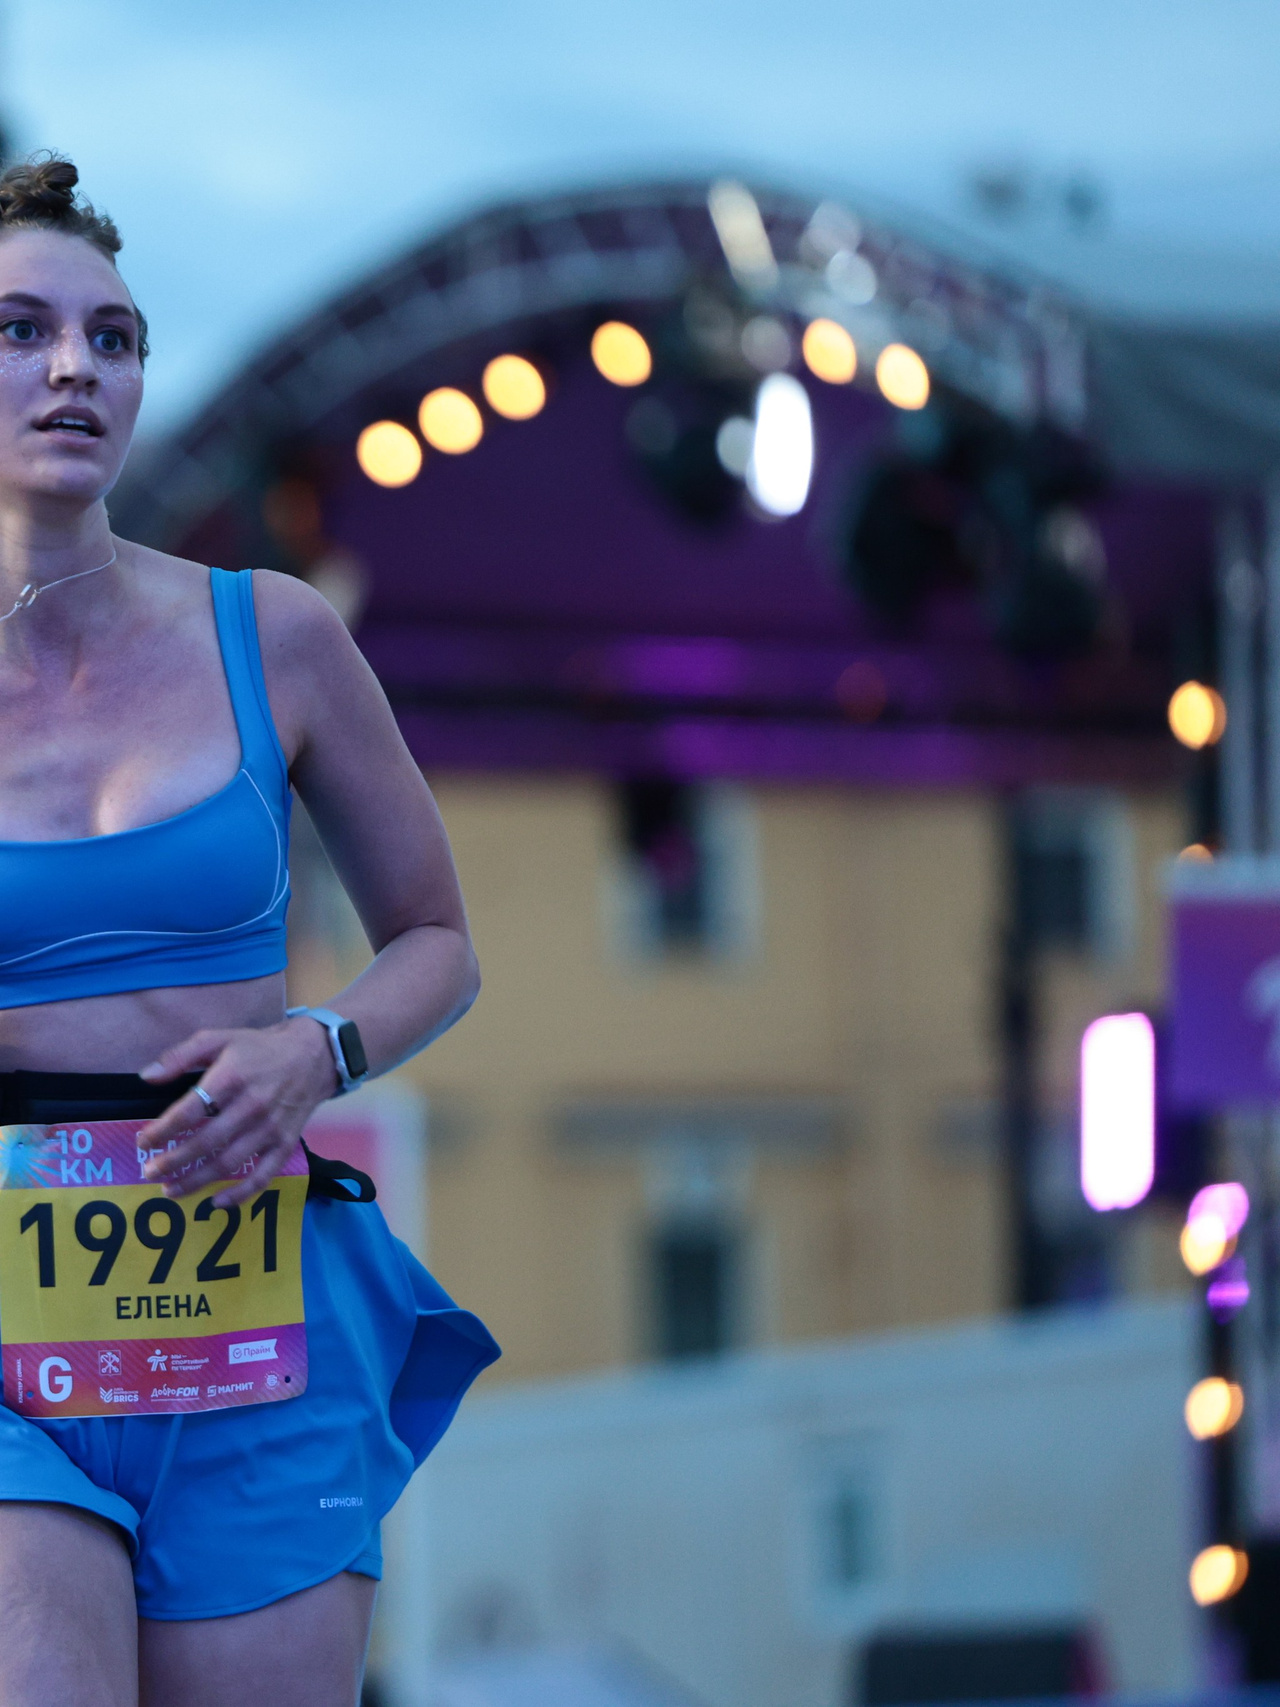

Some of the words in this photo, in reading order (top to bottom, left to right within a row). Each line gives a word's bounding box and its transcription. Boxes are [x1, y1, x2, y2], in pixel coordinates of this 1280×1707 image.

[55, 1128, 93, 1155] 10
[19, 1189, 281, 1288] 19921
[115, 1293, 212, 1320] ЕЛЕНА
[243, 1345, 271, 1357] Прайм
[38, 1355, 73, 1403] G
[217, 1381, 254, 1394] МАГНИТ
[113, 1394, 139, 1403] BRICS
[319, 1496, 364, 1509] EUPHORIA
